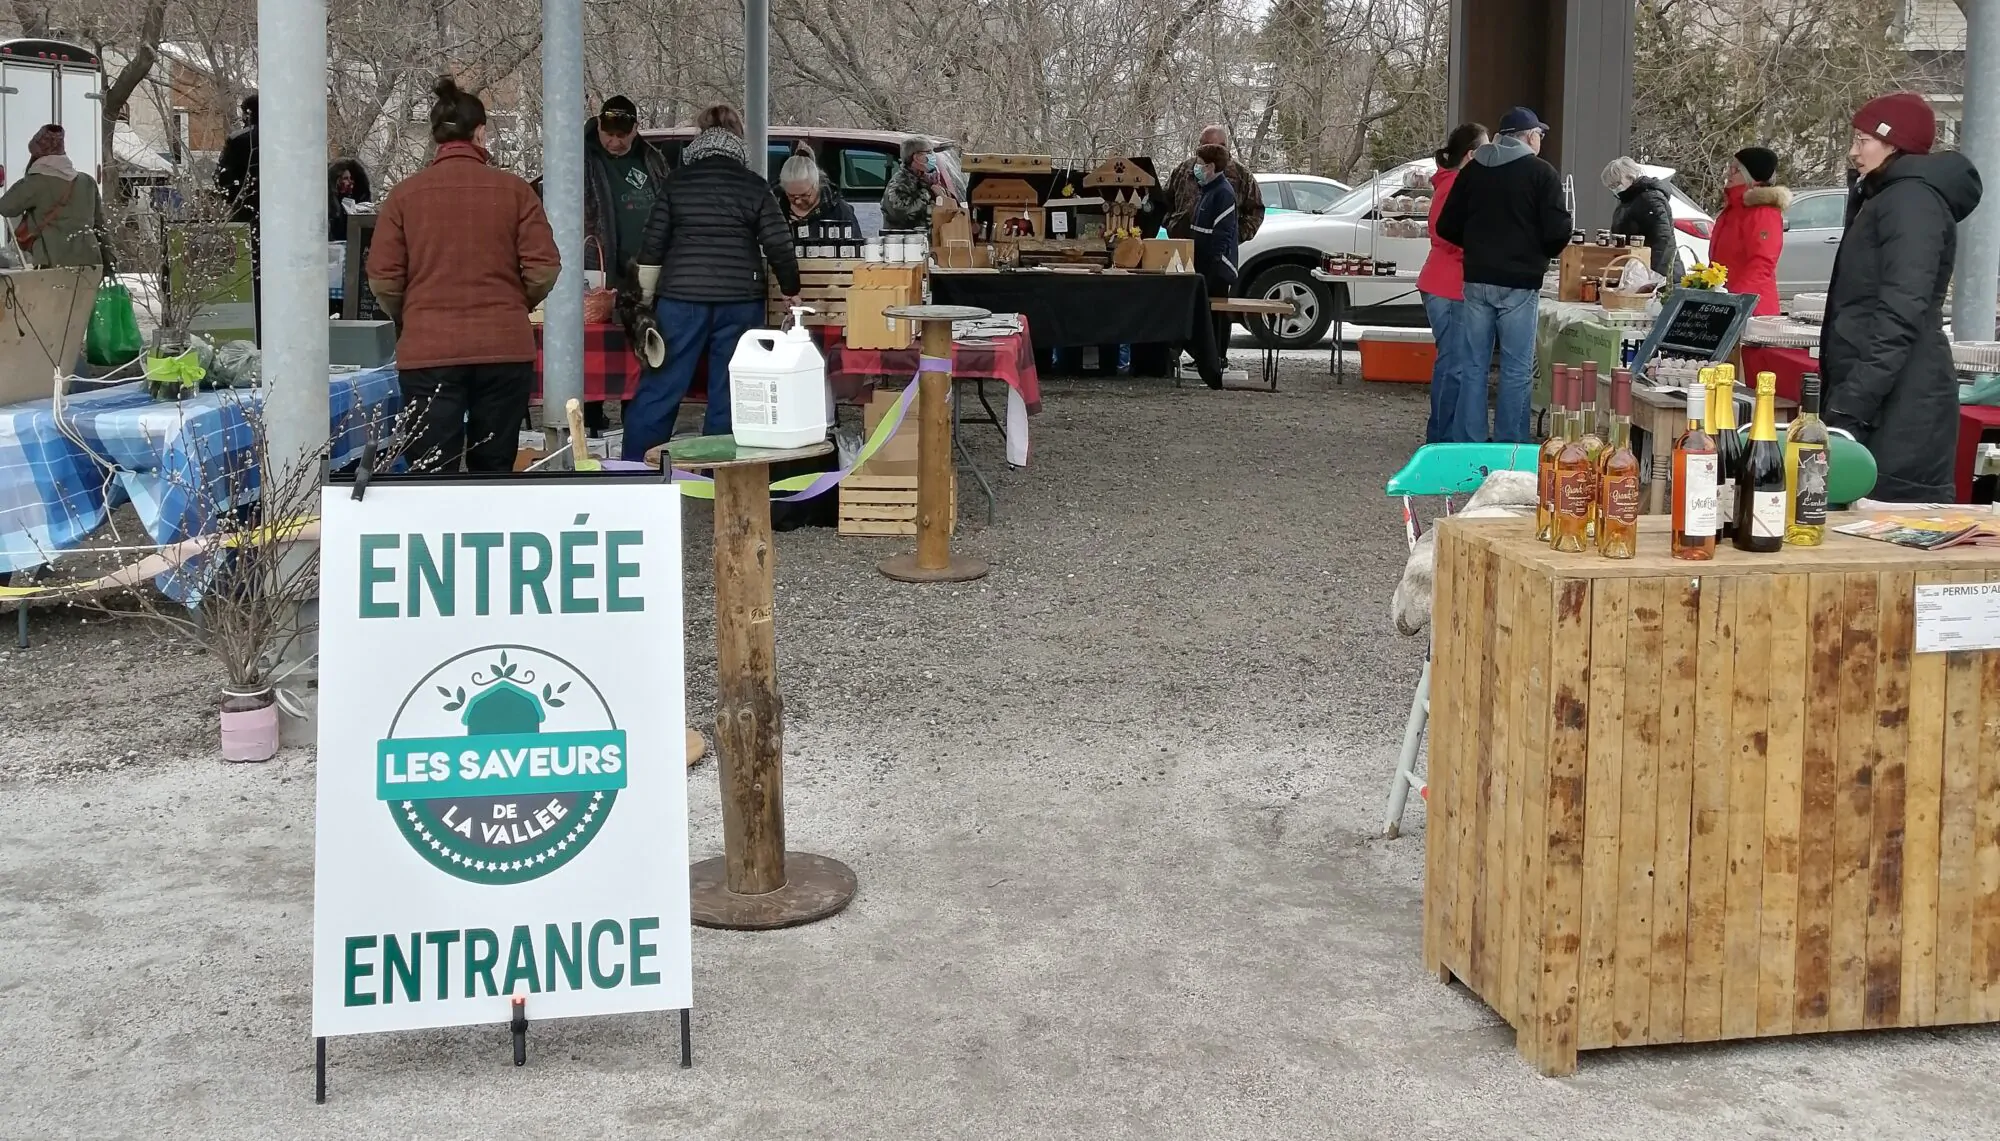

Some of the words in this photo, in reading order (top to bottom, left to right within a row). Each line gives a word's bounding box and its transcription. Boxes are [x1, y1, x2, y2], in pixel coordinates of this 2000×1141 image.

[359, 513, 645, 619] ENTRÉE
[1942, 586, 1979, 596] PERMIS
[386, 752, 450, 784] LES
[459, 744, 622, 780] SAVEURS
[441, 806, 472, 838] LA
[481, 798, 568, 845] VALLÉE
[493, 803, 518, 819] DE
[344, 916, 661, 1008] ENTRANCE
